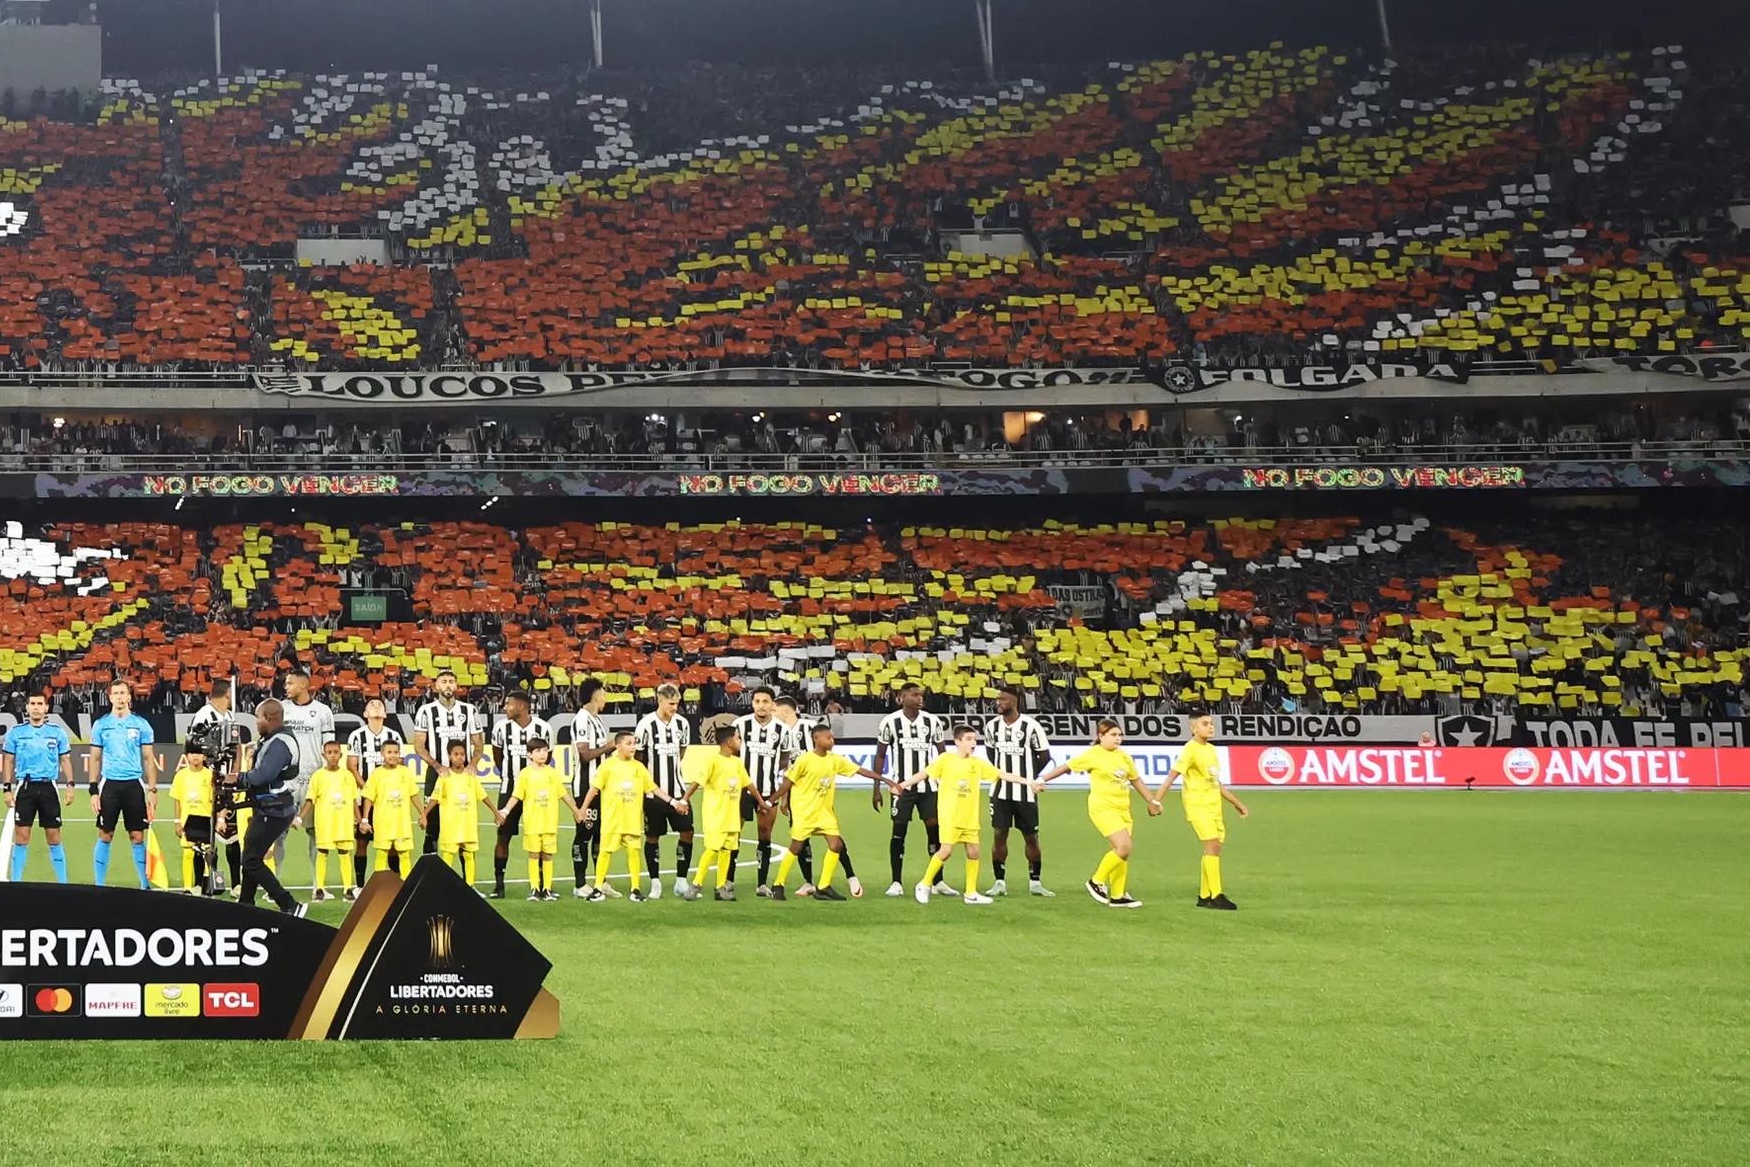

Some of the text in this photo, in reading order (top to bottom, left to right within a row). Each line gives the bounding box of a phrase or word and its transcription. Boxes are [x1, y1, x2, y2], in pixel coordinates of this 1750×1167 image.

[1611, 355, 1750, 380] TOR
[303, 374, 546, 398] LOUCOS
[143, 475, 187, 494] NO
[680, 475, 723, 494] NO
[1242, 468, 1290, 487] NO
[1036, 715, 1181, 737] SENTDOS
[423, 973, 460, 983] CONMEBOL
[208, 991, 254, 1008] TCL
[390, 985, 494, 999] LIBERTADORES
[88, 1001, 138, 1010] MAPFRE
[155, 1001, 189, 1009] mercado
[376, 1003, 508, 1014] A GLÓRIA ETERNA
